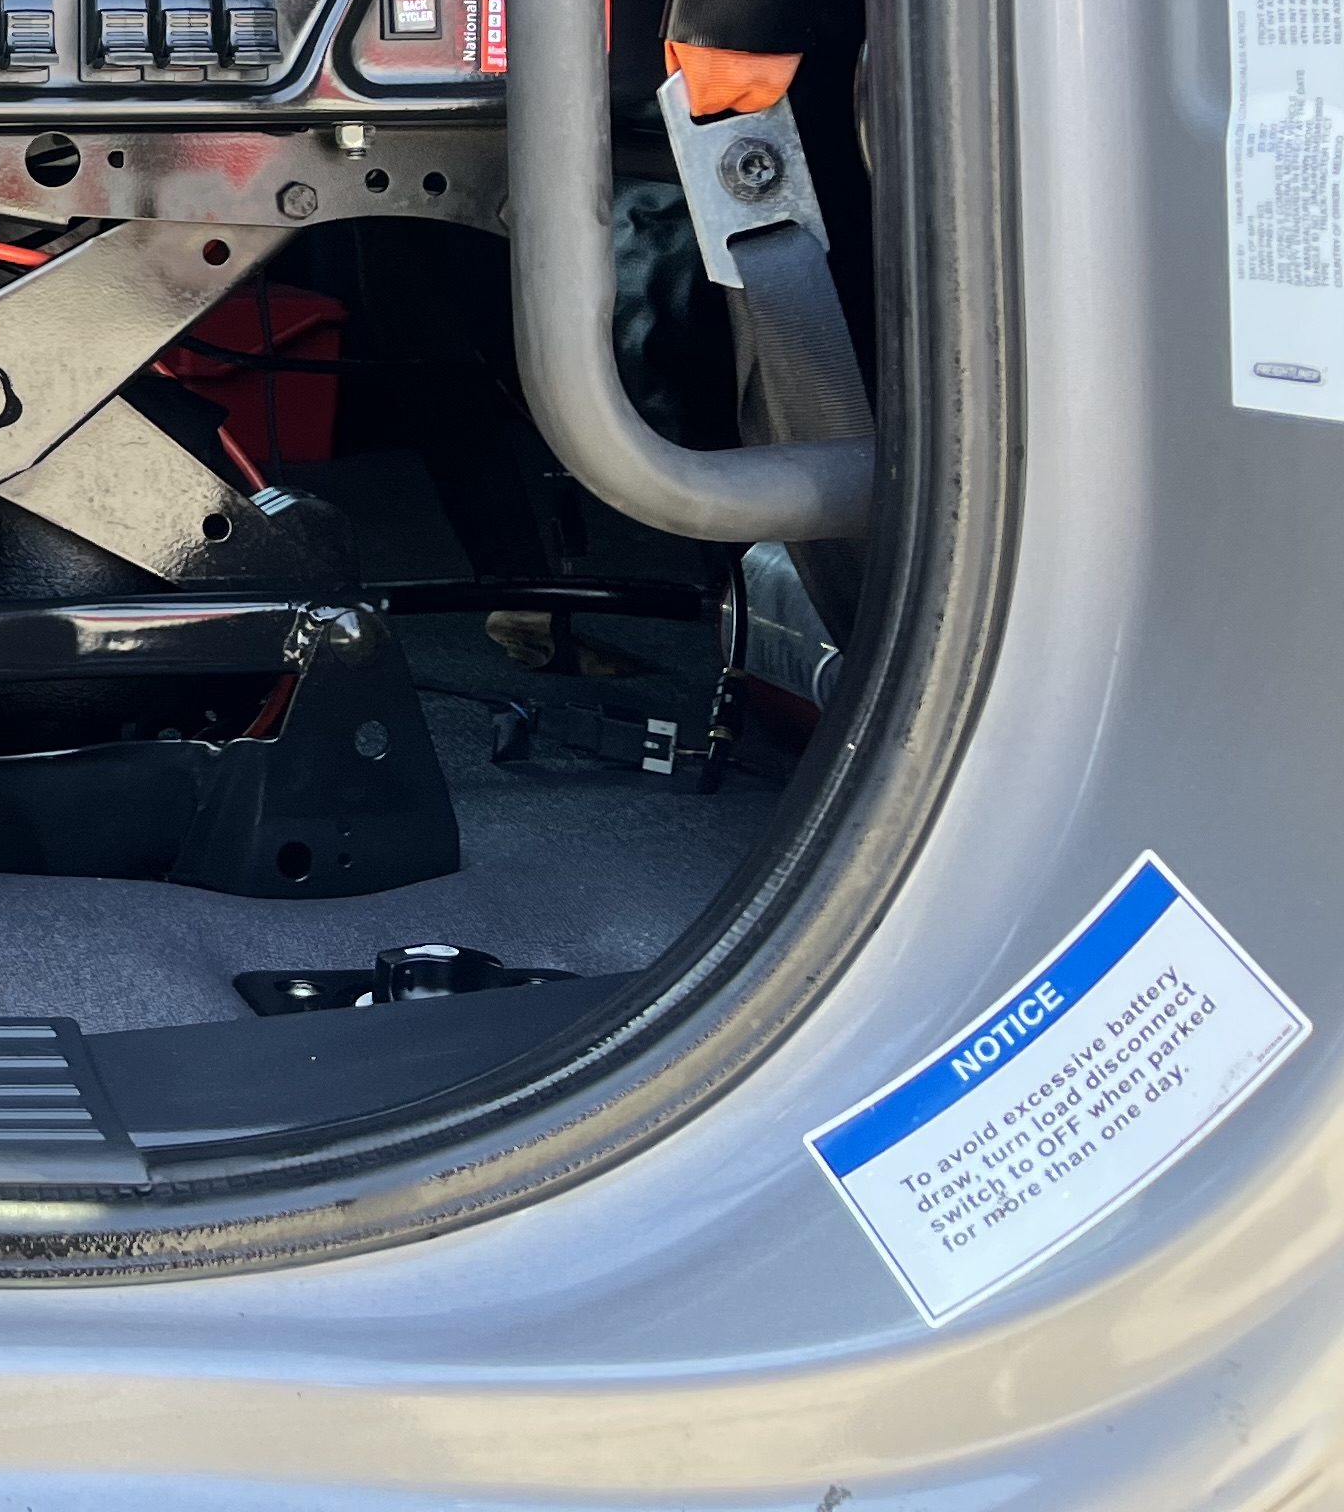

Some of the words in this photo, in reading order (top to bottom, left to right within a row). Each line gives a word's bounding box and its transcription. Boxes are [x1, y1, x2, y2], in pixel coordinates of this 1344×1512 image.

[398, 10, 434, 23] CYCLER
[402, 0, 428, 11] BACK
[900, 1168, 933, 1194] To
[936, 1120, 1000, 1175] avoid
[1002, 1034, 1108, 1128] excessive
[1106, 963, 1182, 1039] battery
[915, 1166, 984, 1215] draw,
[982, 1128, 1032, 1174] turn
[1032, 1088, 1085, 1133] load
[1084, 982, 1199, 1092] disconnect
[929, 1173, 1007, 1235] switch
[1007, 1154, 1036, 1180] to
[1037, 1115, 1085, 1160] OFF
[1086, 1065, 1148, 1120] when
[1146, 995, 1219, 1076] parked
[950, 979, 1066, 1083] NOTICE
[940, 1222, 979, 1254] for
[982, 1180, 1045, 1226] more
[1044, 1135, 1098, 1186] than
[1099, 1105, 1143, 1141] one
[1143, 1062, 1192, 1108] day.
